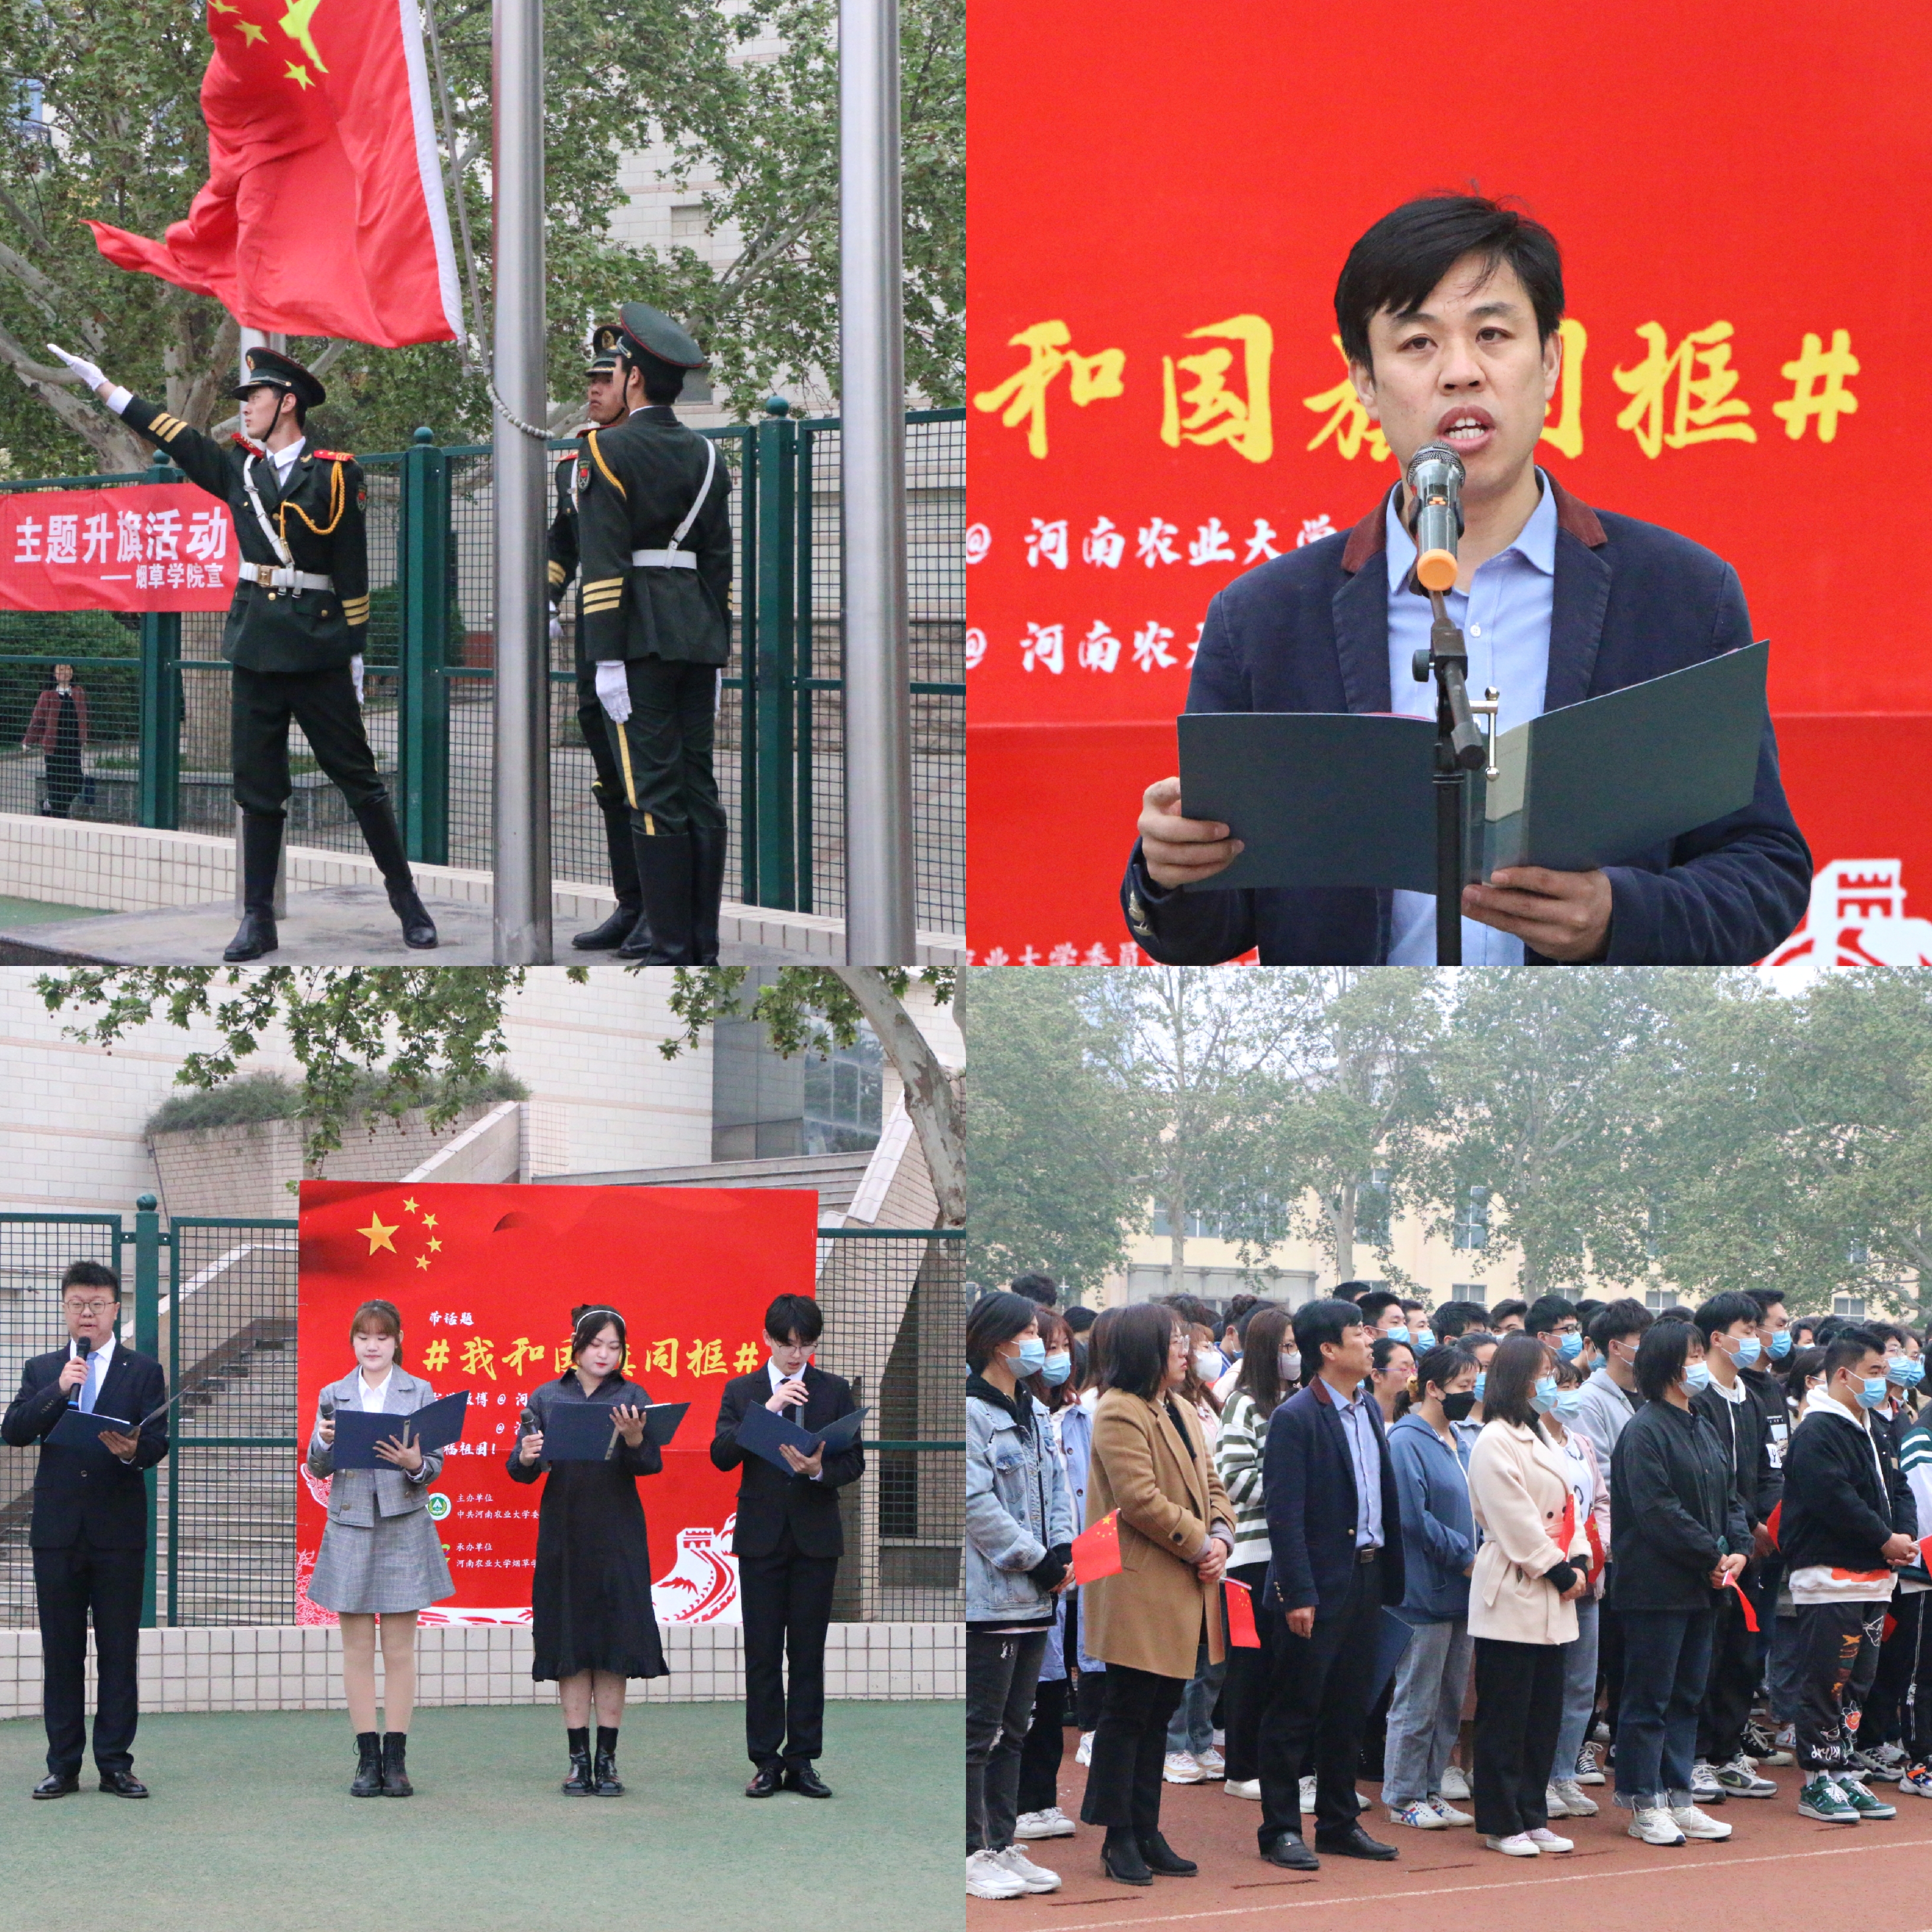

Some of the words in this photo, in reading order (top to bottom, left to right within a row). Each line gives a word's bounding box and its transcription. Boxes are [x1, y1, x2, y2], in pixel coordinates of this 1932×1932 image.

[14, 505, 228, 564] 主题升旗活动
[1019, 620, 1204, 674] 河南农
[429, 1310, 474, 1327] 带话题
[423, 1335, 759, 1381] #我和同框#
[456, 1493, 494, 1503] 主办单位
[456, 1542, 493, 1552] 承办单位
